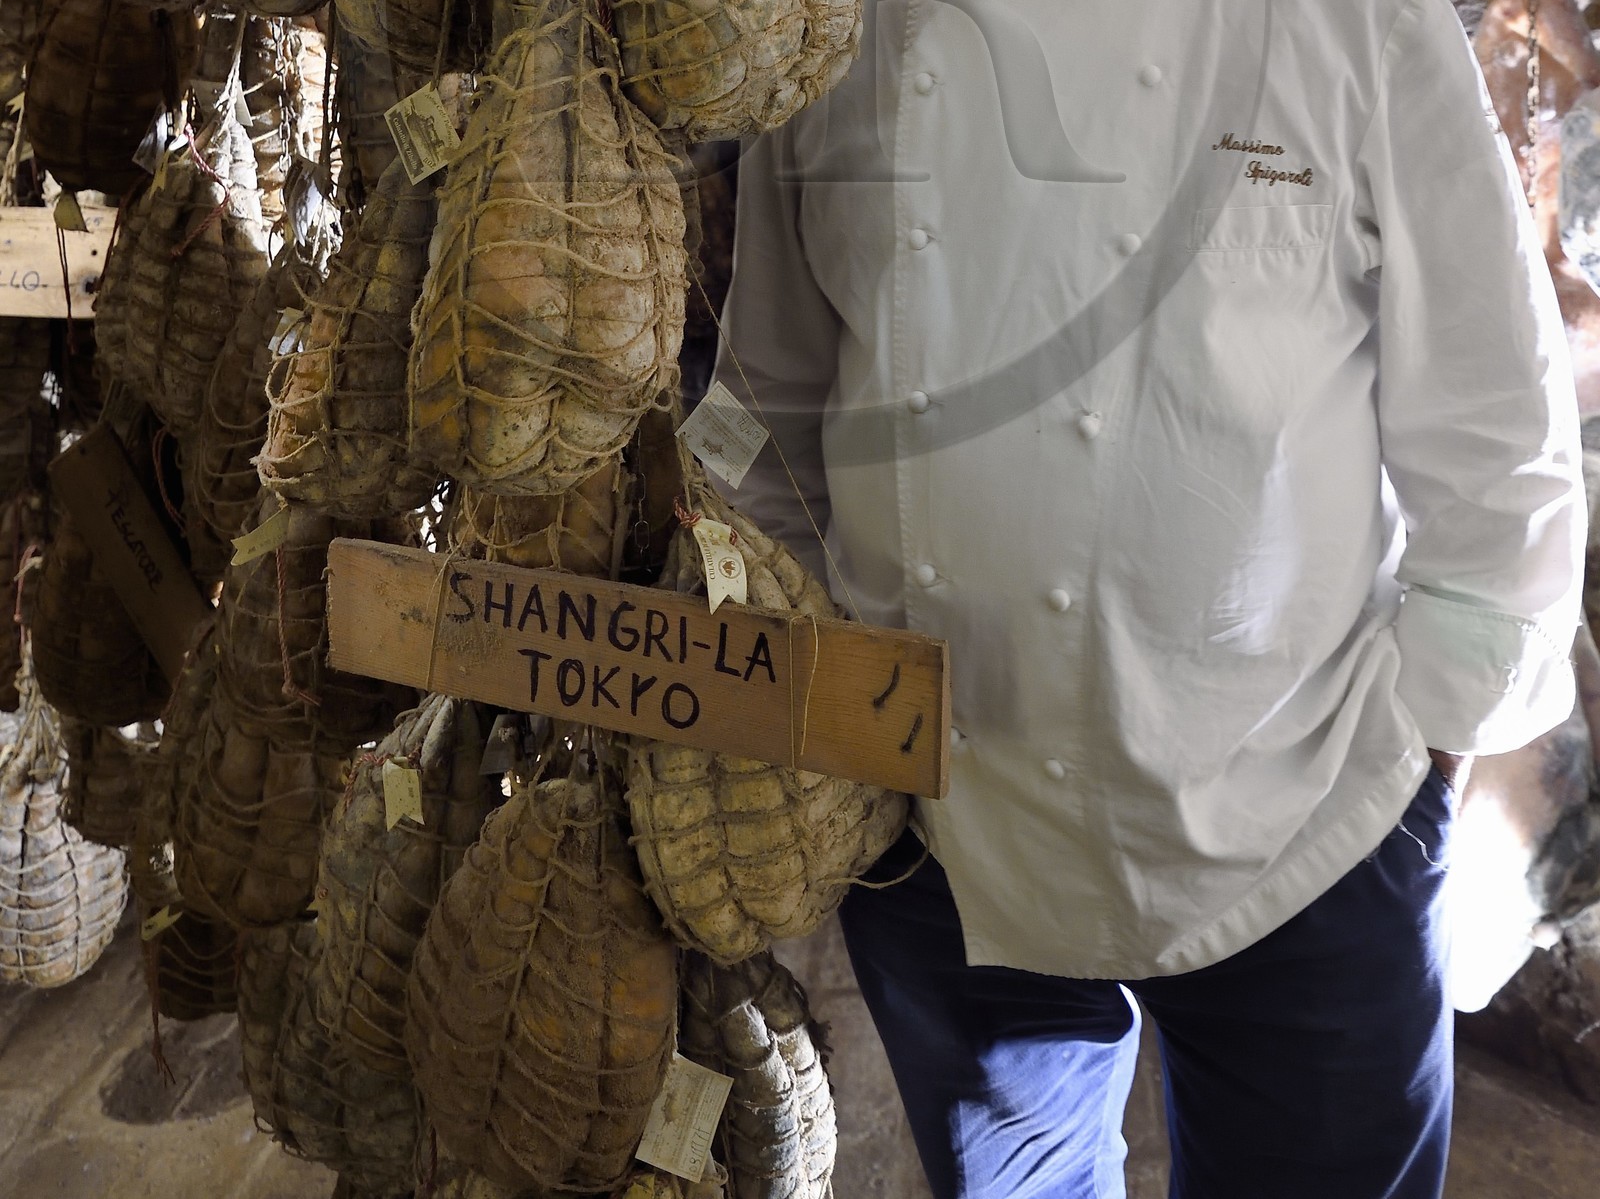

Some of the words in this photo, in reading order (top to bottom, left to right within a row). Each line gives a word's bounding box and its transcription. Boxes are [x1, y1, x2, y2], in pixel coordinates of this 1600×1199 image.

[1212, 132, 1286, 156] Massimo
[445, 572, 777, 684] SHANGRI-LA
[517, 648, 701, 730] TOKYO
